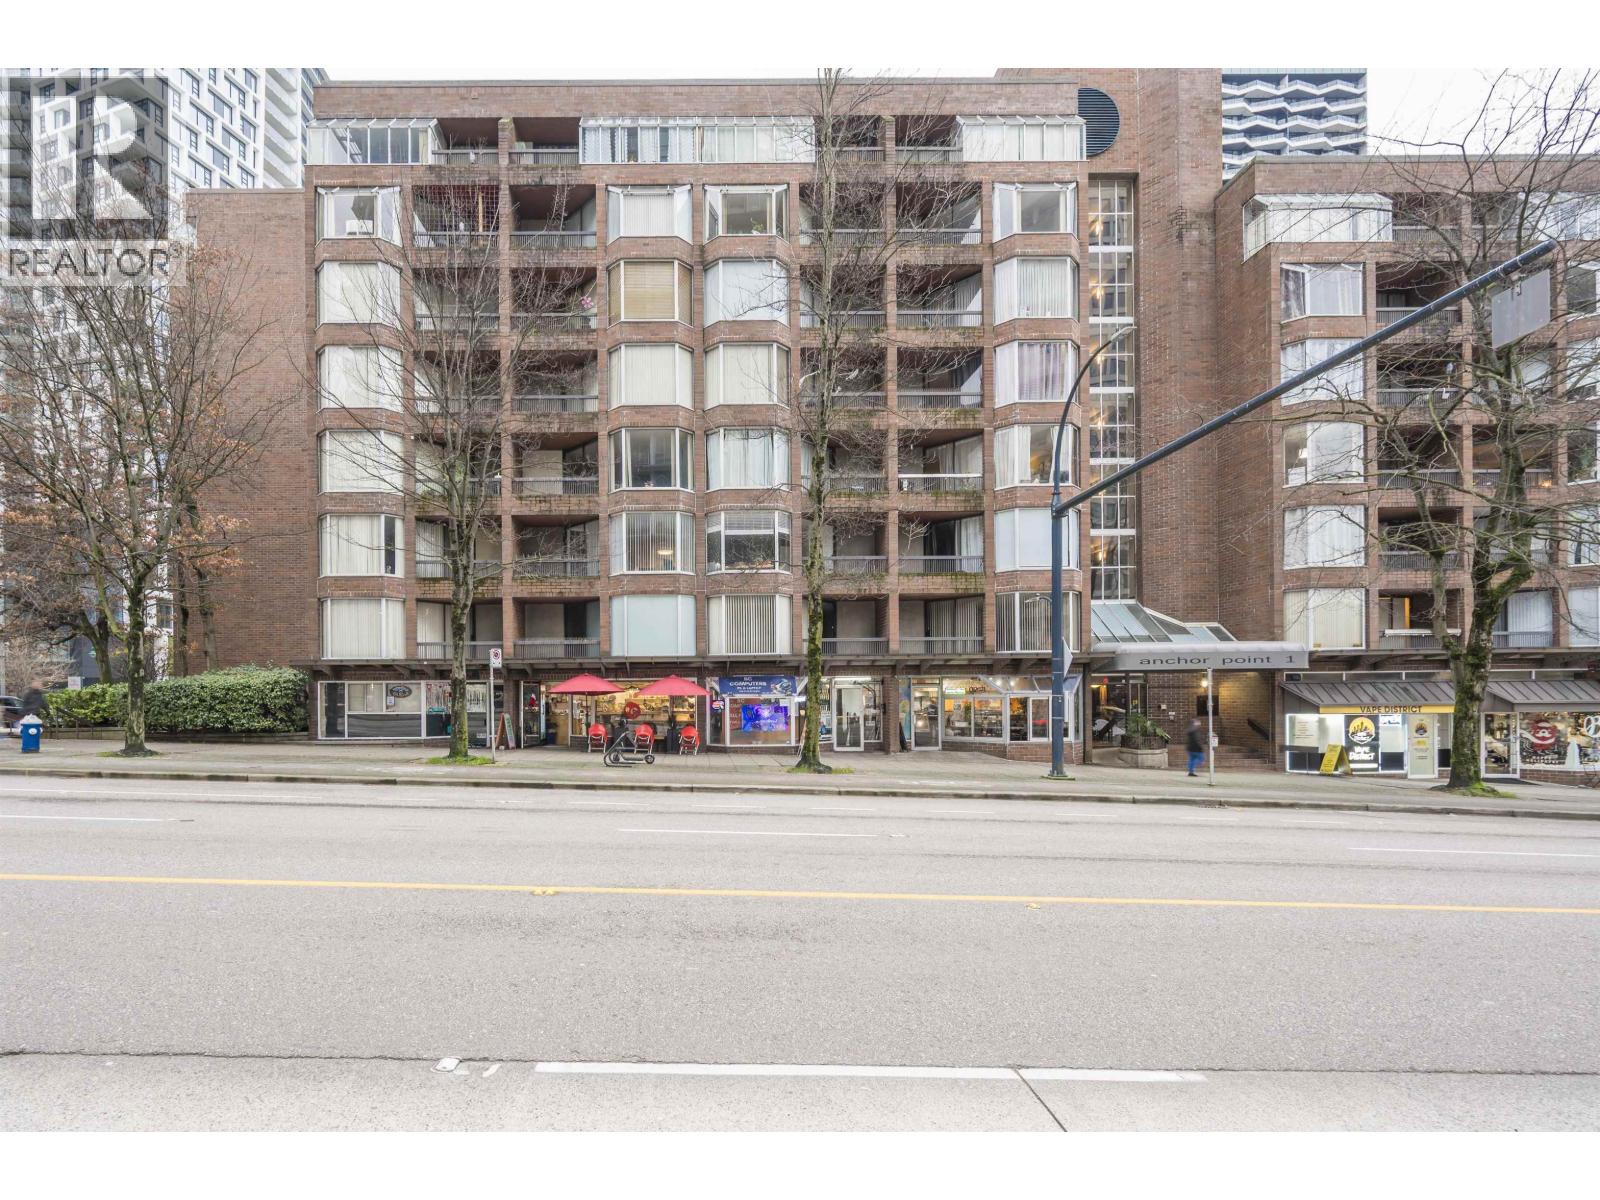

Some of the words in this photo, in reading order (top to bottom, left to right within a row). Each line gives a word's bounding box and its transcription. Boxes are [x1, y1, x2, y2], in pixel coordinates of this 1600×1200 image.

[1139, 654, 1210, 666] anchor
[1221, 655, 1271, 667] point
[1285, 655, 1296, 664] 1
[1360, 705, 1382, 713] VAPE
[1384, 705, 1422, 713] DISTRICT
